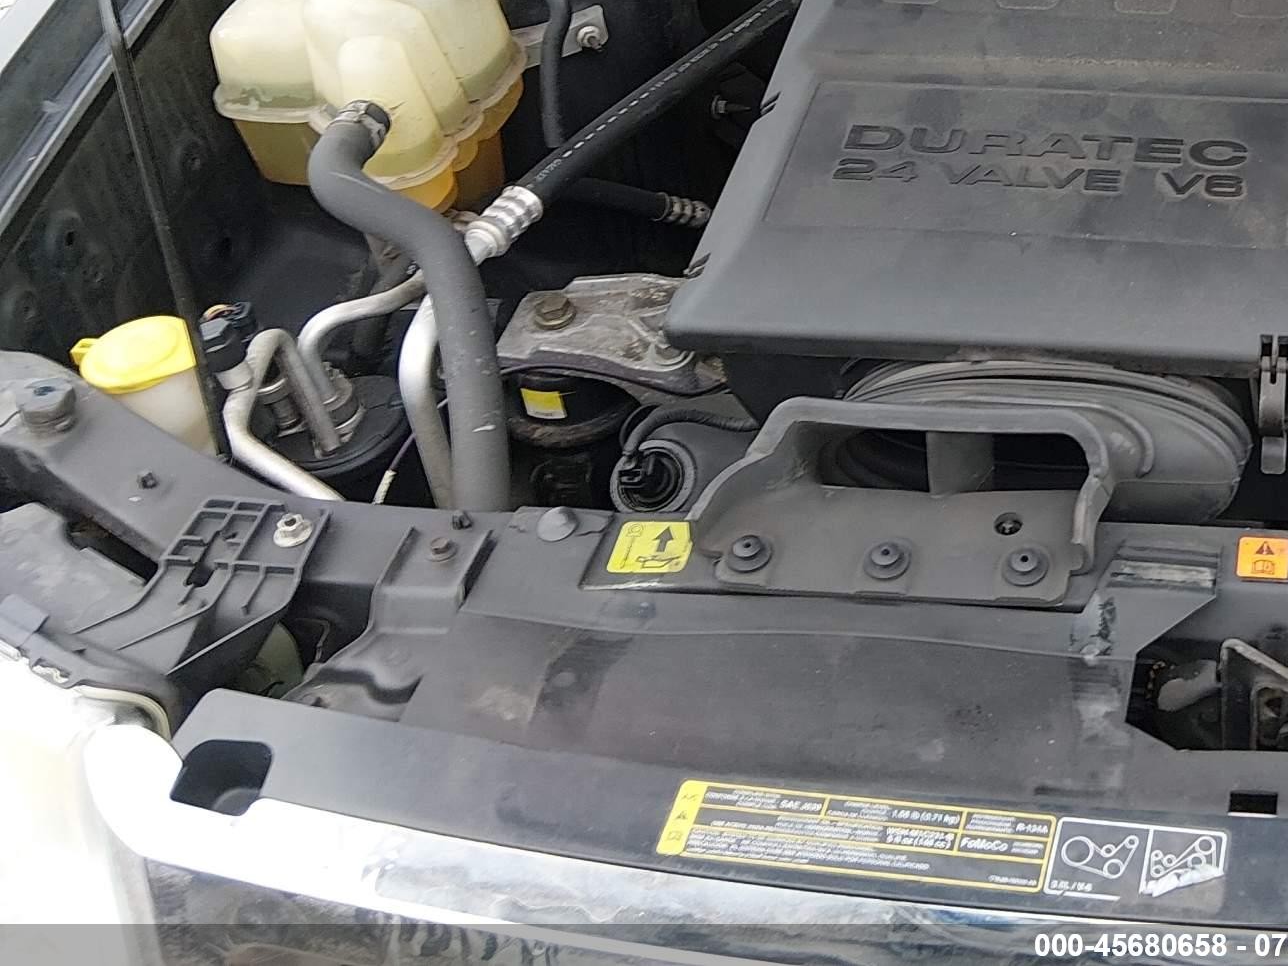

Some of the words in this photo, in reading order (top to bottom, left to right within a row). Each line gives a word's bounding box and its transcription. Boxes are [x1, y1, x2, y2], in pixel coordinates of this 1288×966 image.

[843, 124, 1249, 166] DURATEC
[832, 157, 918, 183] 24
[940, 162, 1122, 192] VALVE
[1161, 171, 1246, 198] V6
[960, 836, 1009, 852] FoMoCo
